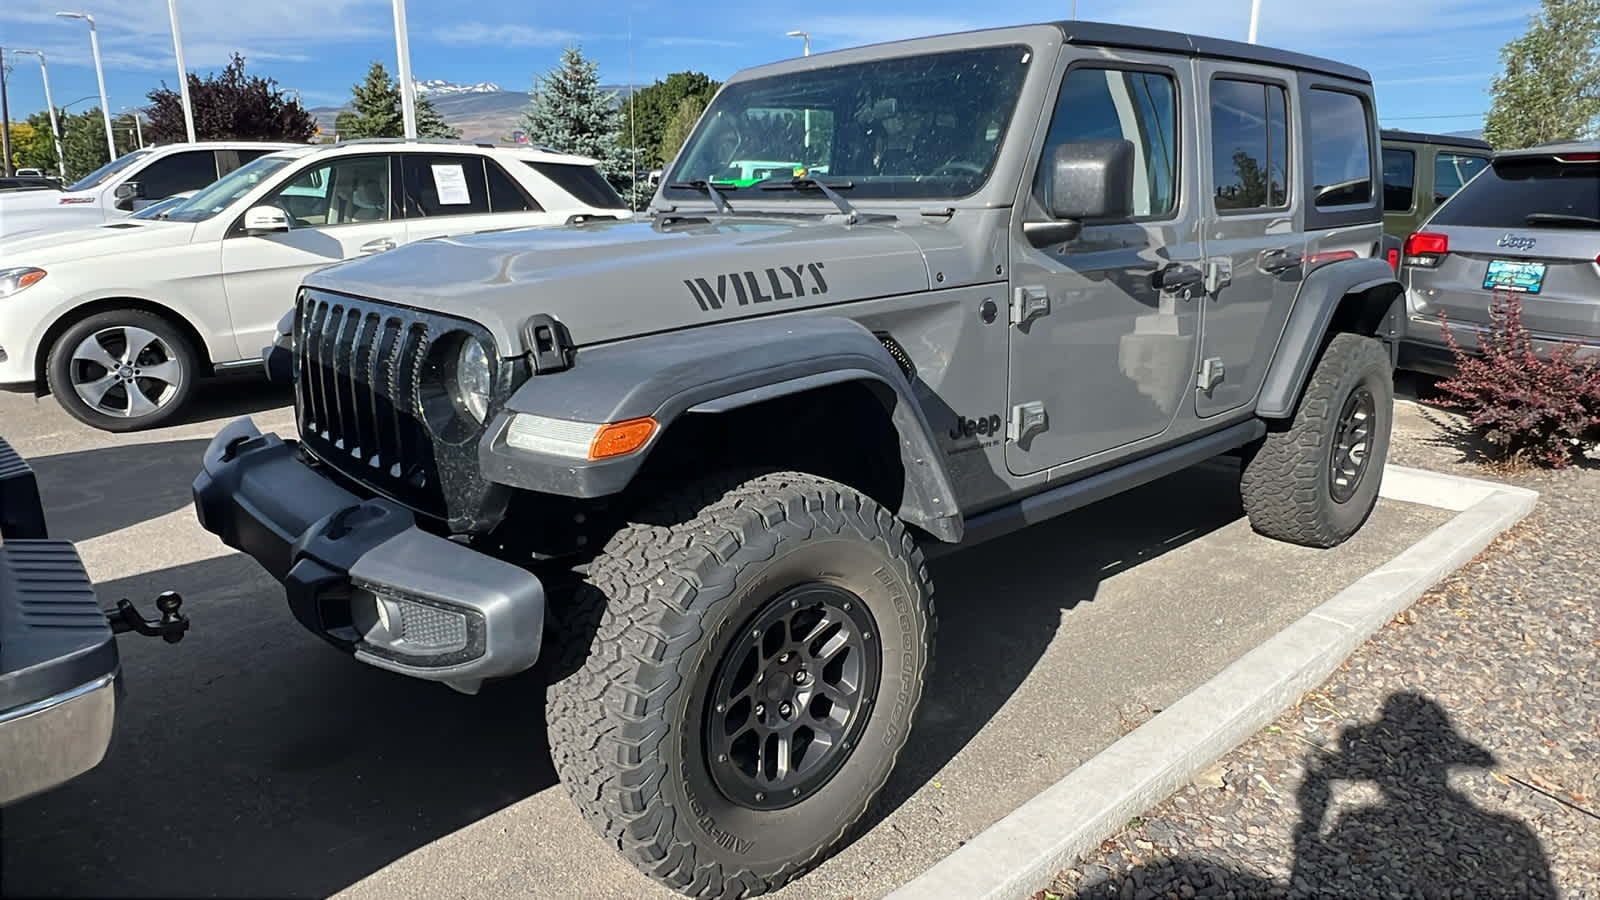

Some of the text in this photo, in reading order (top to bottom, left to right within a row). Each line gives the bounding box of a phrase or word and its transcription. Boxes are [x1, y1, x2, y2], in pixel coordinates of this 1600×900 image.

[1496, 232, 1537, 251] Jeep
[683, 262, 828, 312] WILLYS
[949, 414, 1001, 440] Jeep
